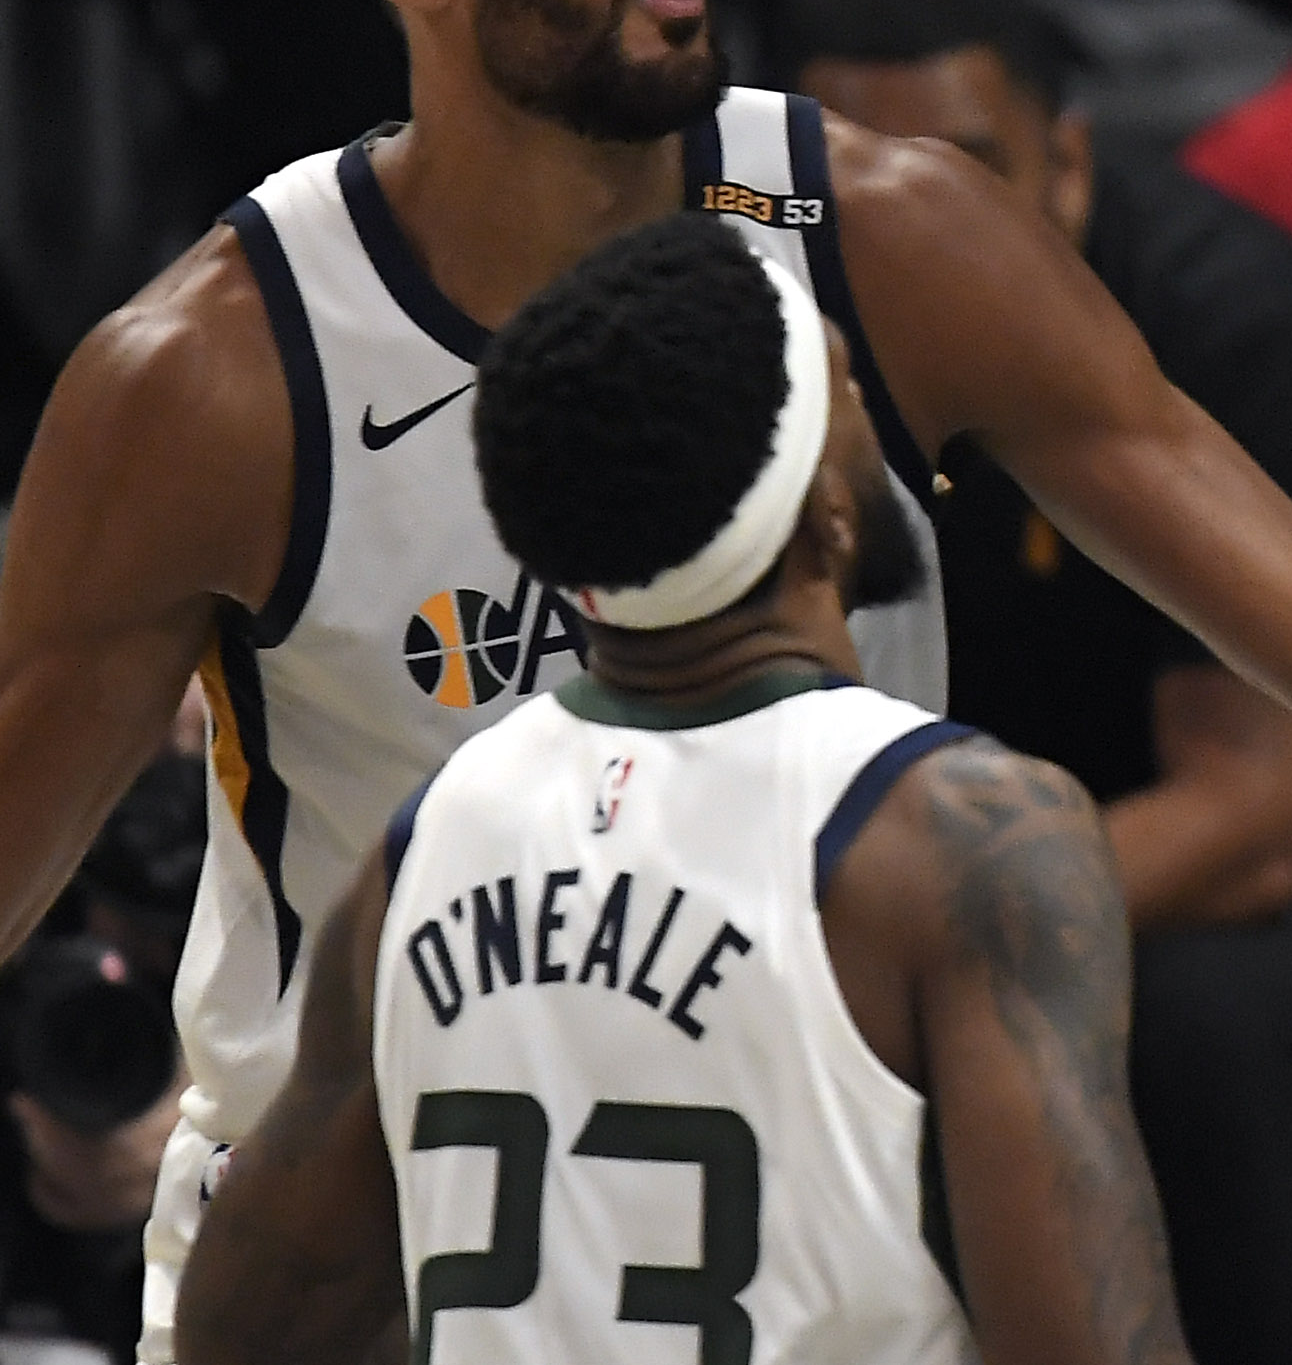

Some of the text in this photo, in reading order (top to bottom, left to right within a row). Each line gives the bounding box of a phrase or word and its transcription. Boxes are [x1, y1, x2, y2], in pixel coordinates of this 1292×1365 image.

[702, 184, 824, 225] 1223 53
[406, 867, 754, 1041] O'NEALE
[409, 1090, 761, 1365] 23
